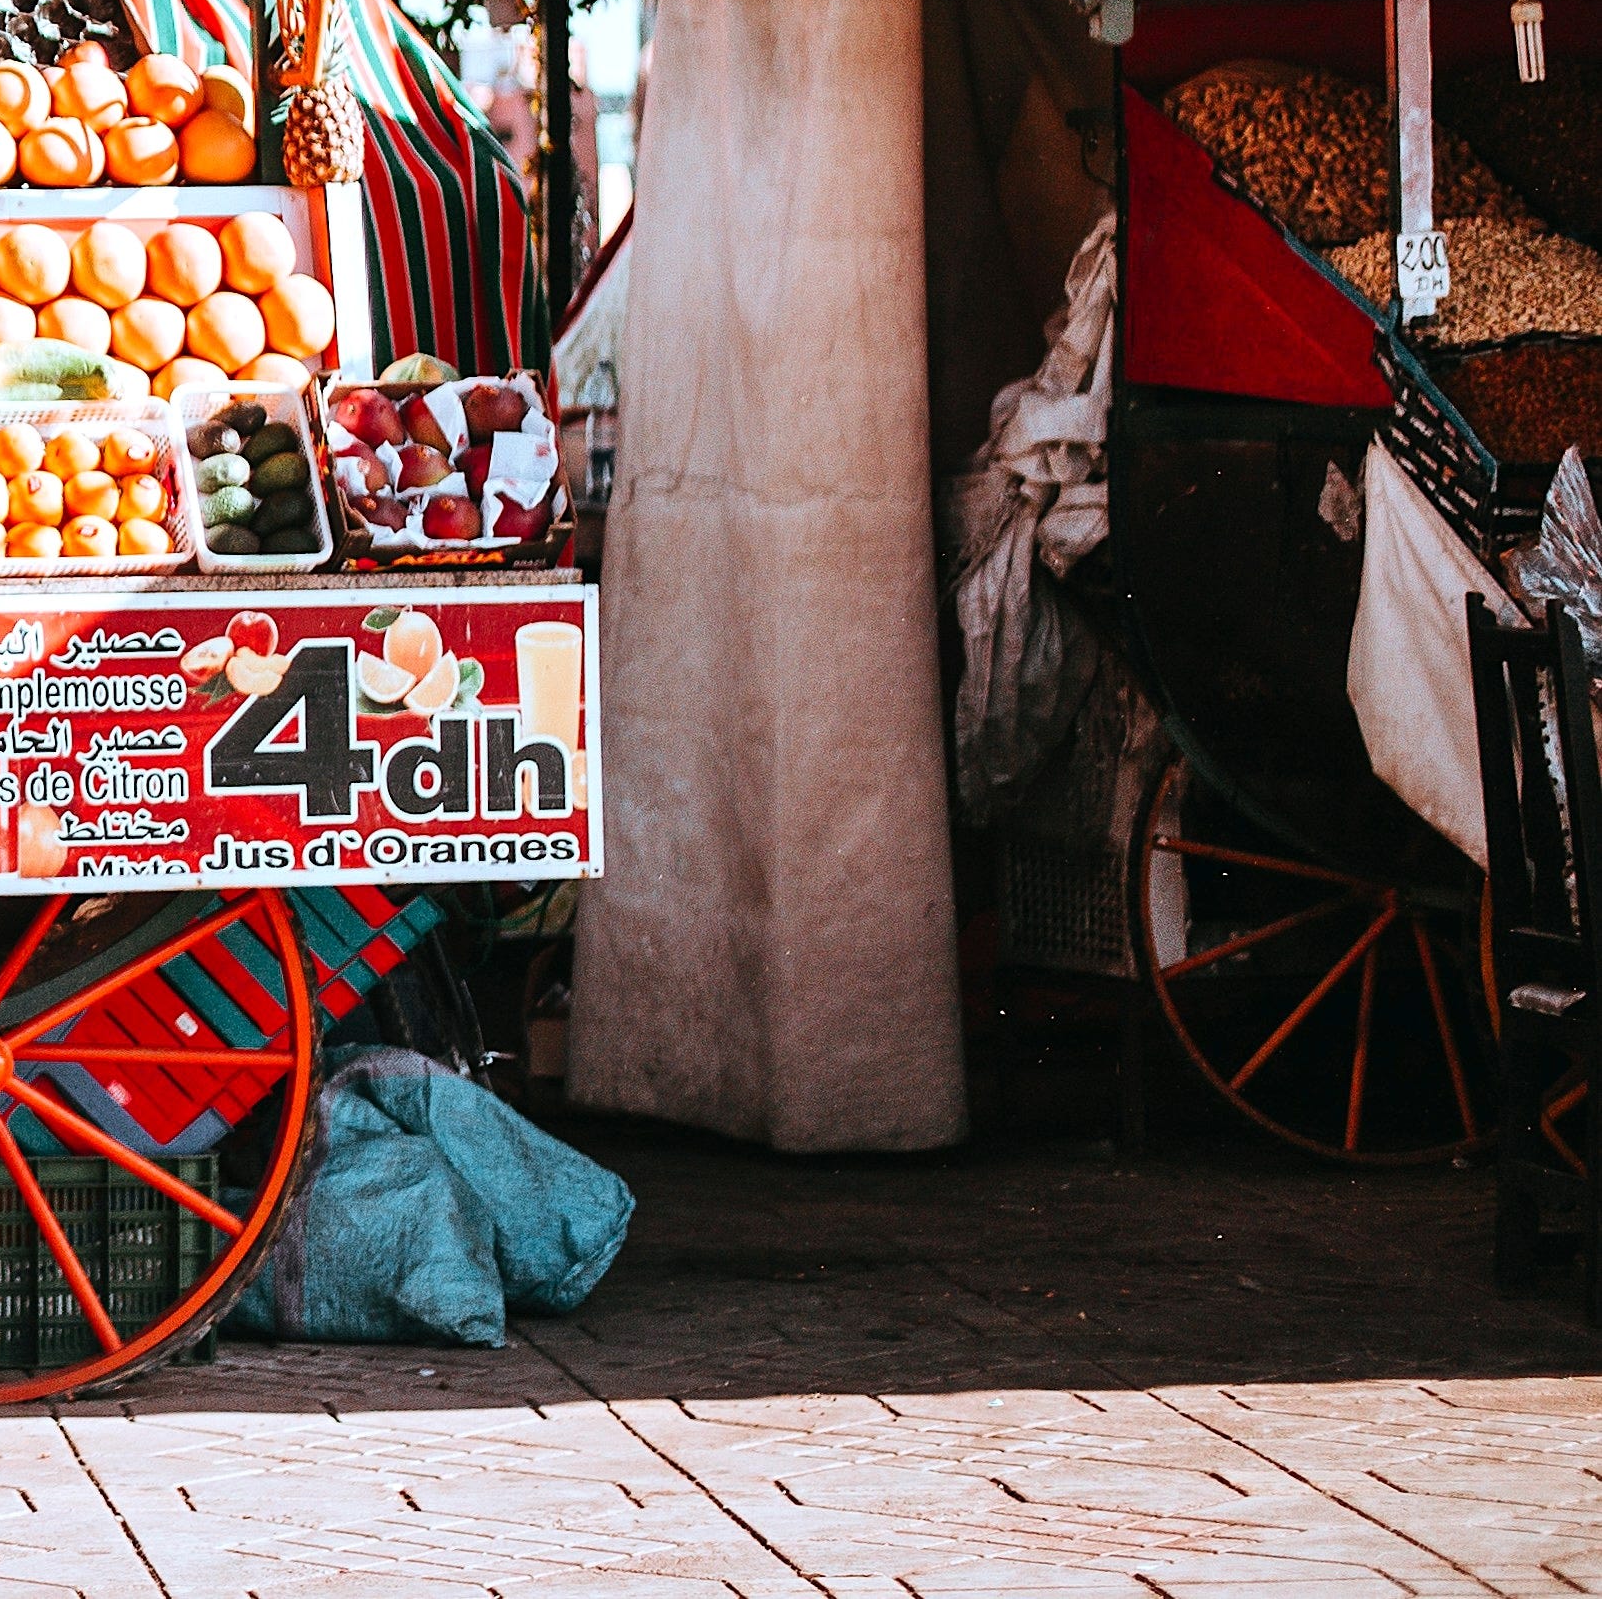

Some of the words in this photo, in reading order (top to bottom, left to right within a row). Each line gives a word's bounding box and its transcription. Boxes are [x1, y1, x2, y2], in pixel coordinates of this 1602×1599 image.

[1400, 236, 1448, 271] 200
[56, 629, 183, 665] عصير
[81, 726, 185, 762] عصير
[30, 766, 71, 802] de
[84, 760, 185, 801] Citron
[58, 813, 186, 841] مختلط
[205, 840, 290, 870] Jus
